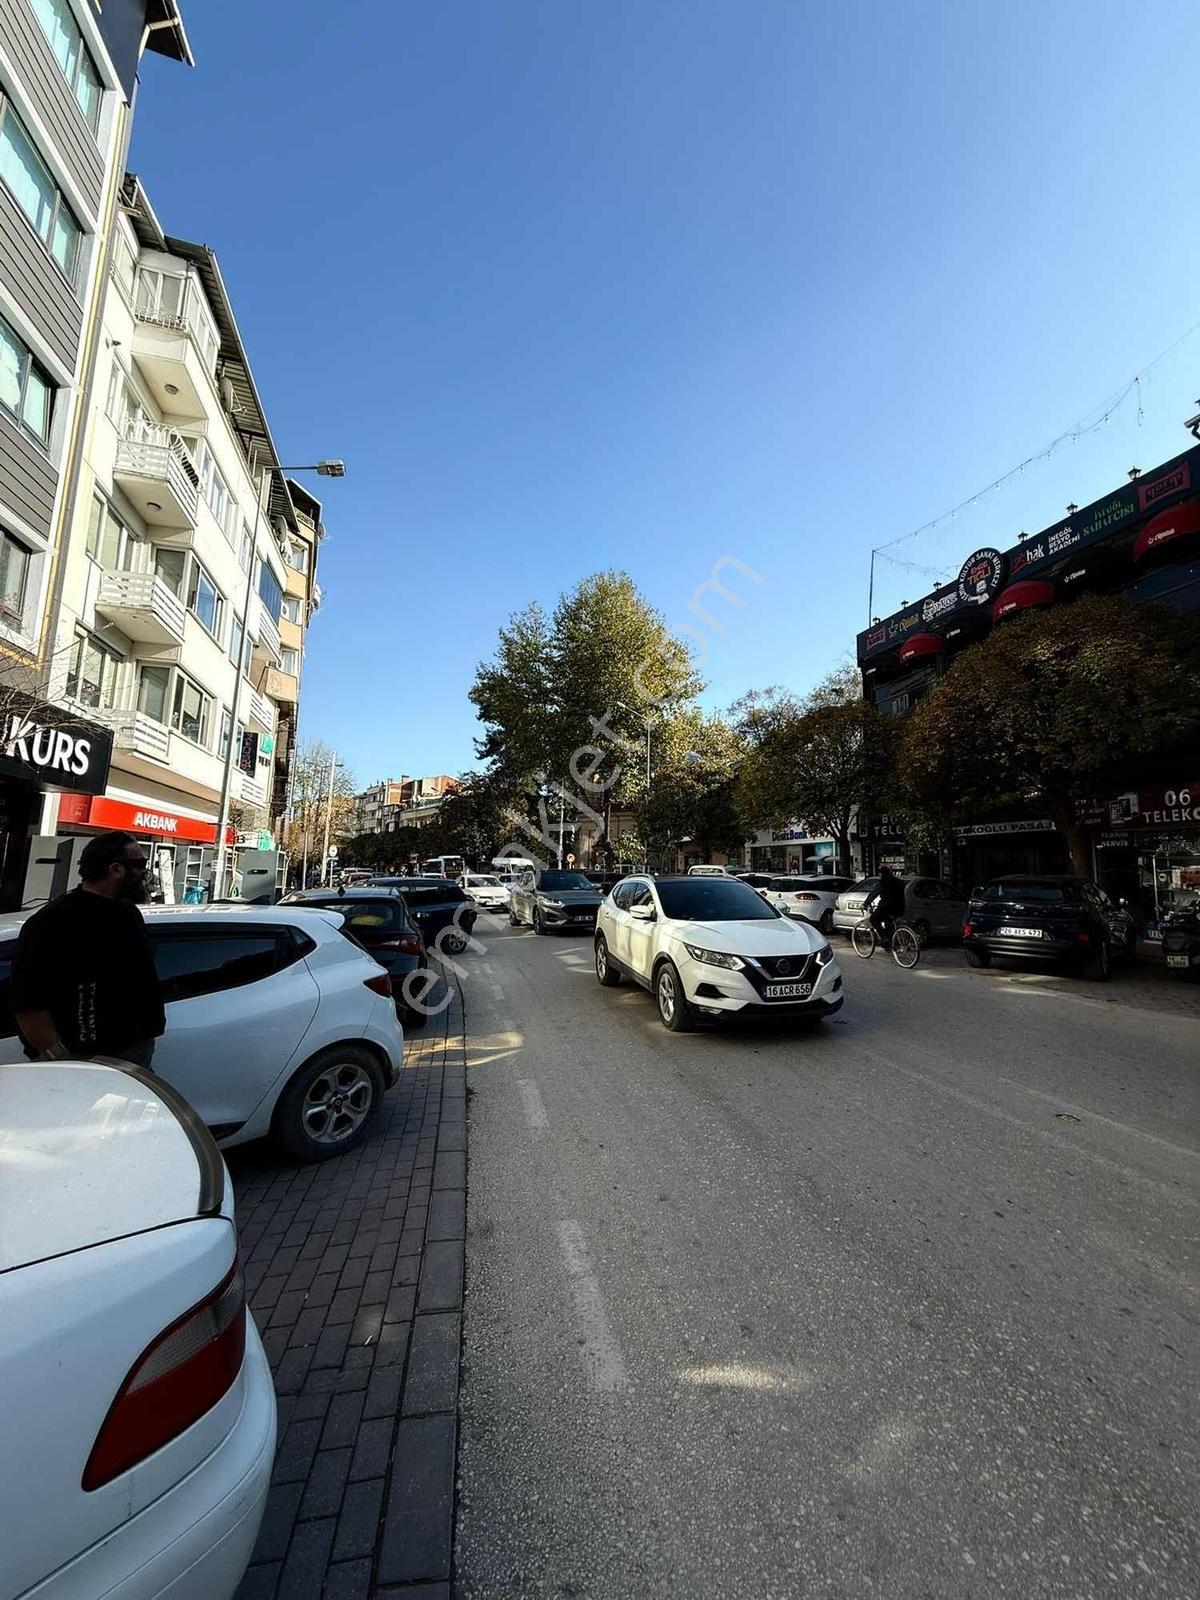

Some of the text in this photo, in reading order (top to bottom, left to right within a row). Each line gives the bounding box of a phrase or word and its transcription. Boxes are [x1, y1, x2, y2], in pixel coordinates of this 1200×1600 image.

[5, 715, 91, 776] KURS
[1164, 788, 1191, 807] 06
[134, 811, 178, 833] AKBANK
[767, 984, 811, 996] 16 ACR 656
